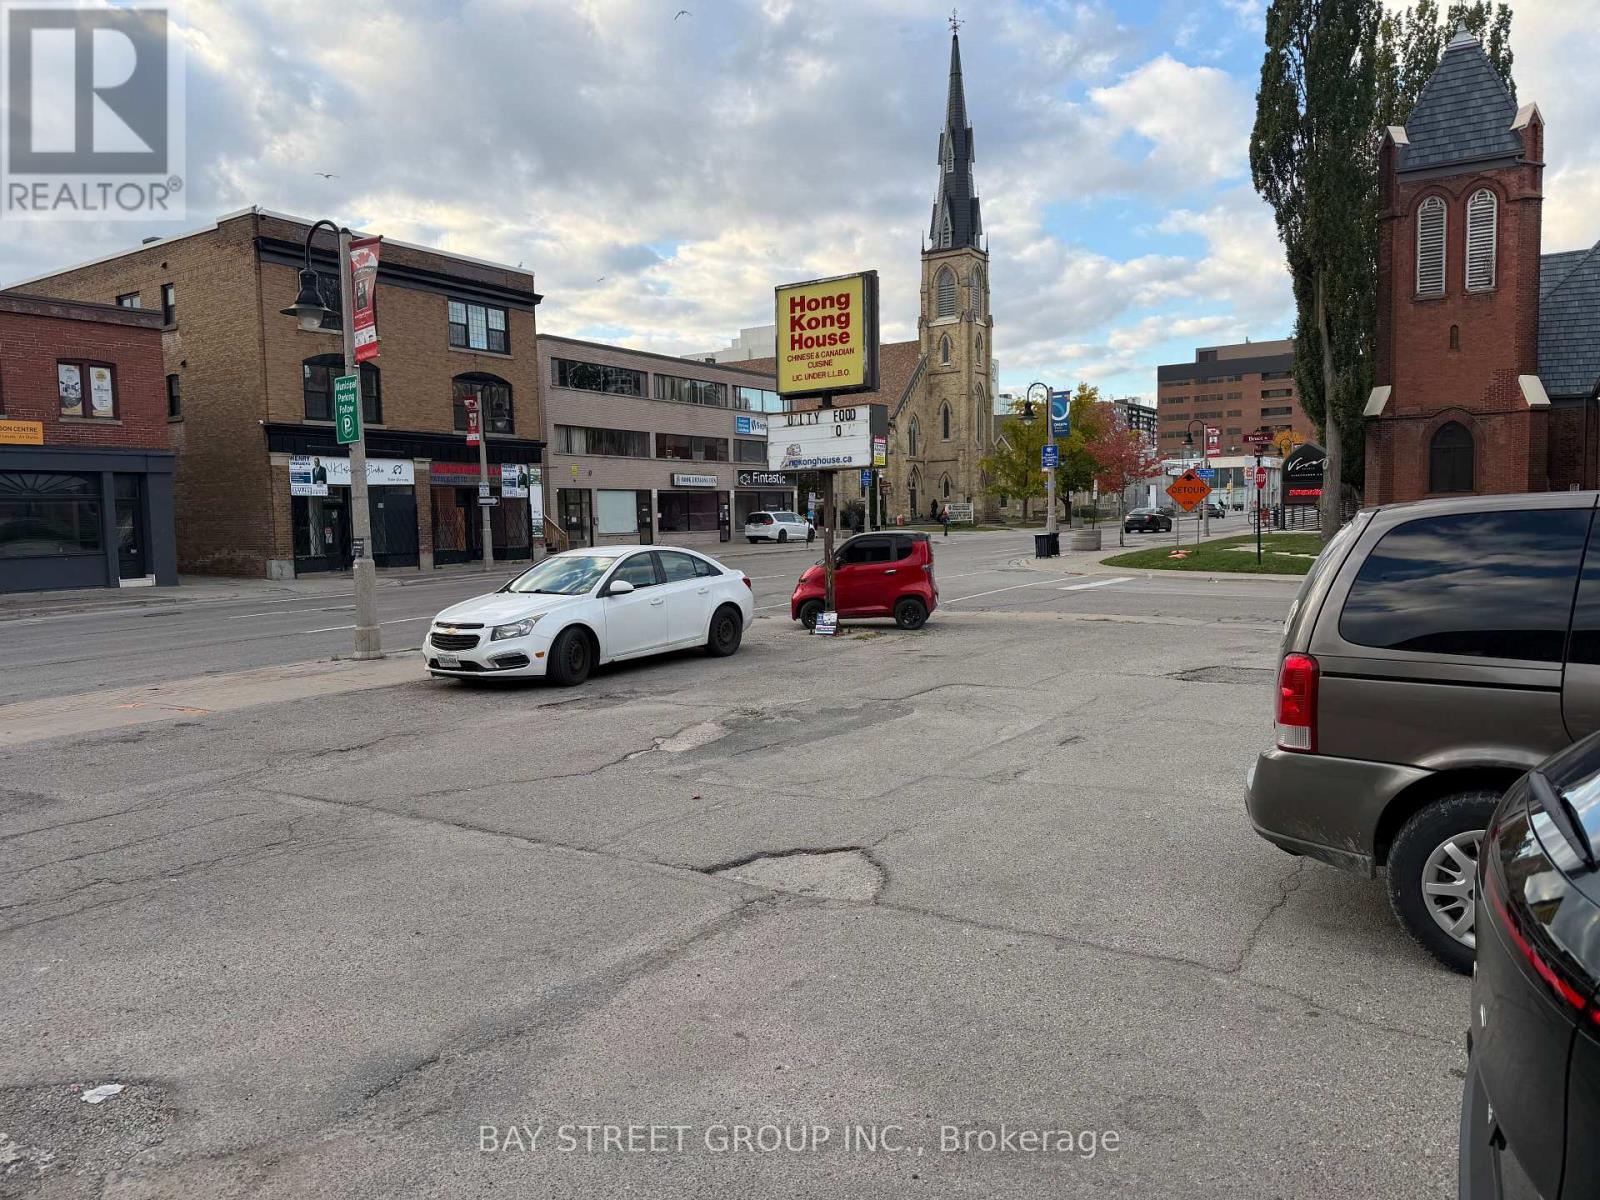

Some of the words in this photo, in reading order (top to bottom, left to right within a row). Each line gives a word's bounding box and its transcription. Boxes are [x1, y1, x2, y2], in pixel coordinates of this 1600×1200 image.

[790, 293, 850, 314] Hong
[790, 312, 850, 333] Kong
[791, 331, 850, 351] House
[787, 352, 815, 362] CHINESE
[821, 347, 855, 358] CANADIAN
[808, 359, 833, 369] CUISINE
[805, 371, 826, 380] UNDER
[335, 380, 357, 391] Municipal
[338, 393, 355, 403] Parking
[339, 405, 354, 414] Follow
[833, 408, 856, 423] FOOD
[752, 472, 786, 484] Fintastic
[1171, 486, 1205, 494] DETOUR
